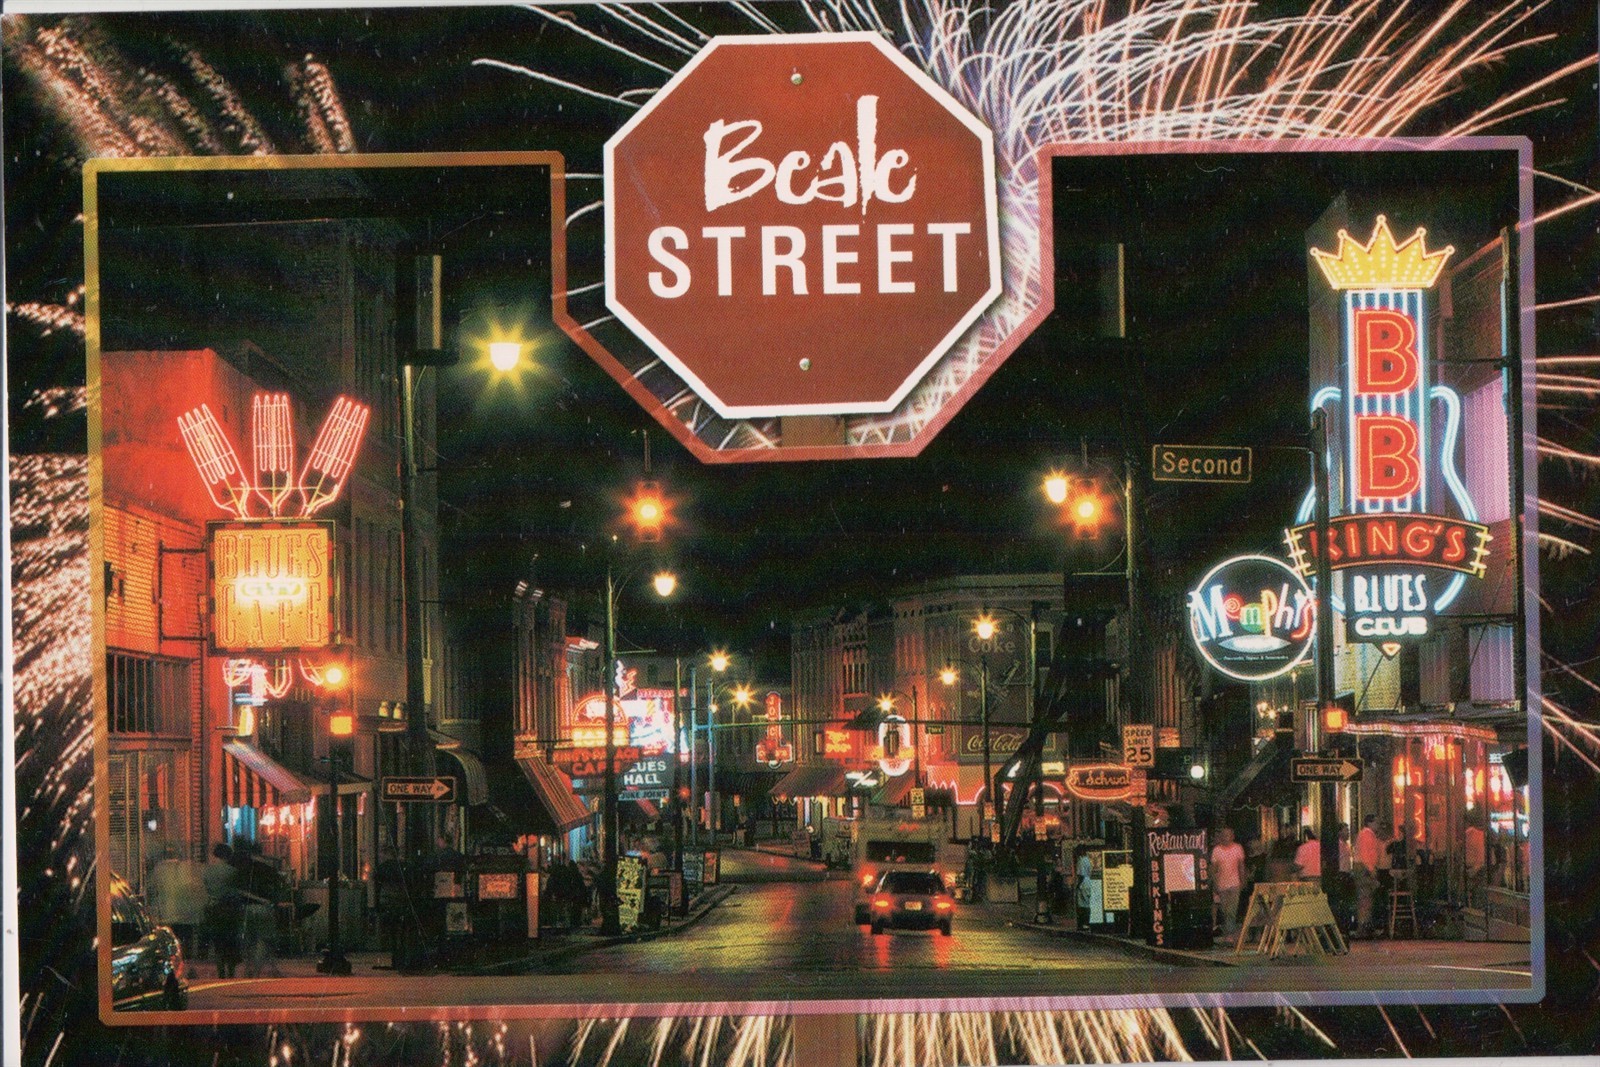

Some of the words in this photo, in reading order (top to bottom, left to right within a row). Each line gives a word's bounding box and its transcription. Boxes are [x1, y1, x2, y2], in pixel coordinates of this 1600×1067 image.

[703, 95, 917, 217] Beale
[647, 223, 971, 299] STREET
[1162, 451, 1242, 475] Second
[1310, 520, 1466, 562] KING'S
[220, 533, 322, 578] BLUES
[1354, 574, 1427, 612] BLUES
[1355, 616, 1428, 636] CLUB
[1126, 747, 1151, 762] 25
[624, 773, 661, 785] HALL
[1300, 765, 1318, 774] ONE
[1322, 765, 1340, 774] WAY
[389, 784, 409, 793] ONE
[412, 784, 431, 793] WAY
[1148, 830, 1208, 857] Restaurant
